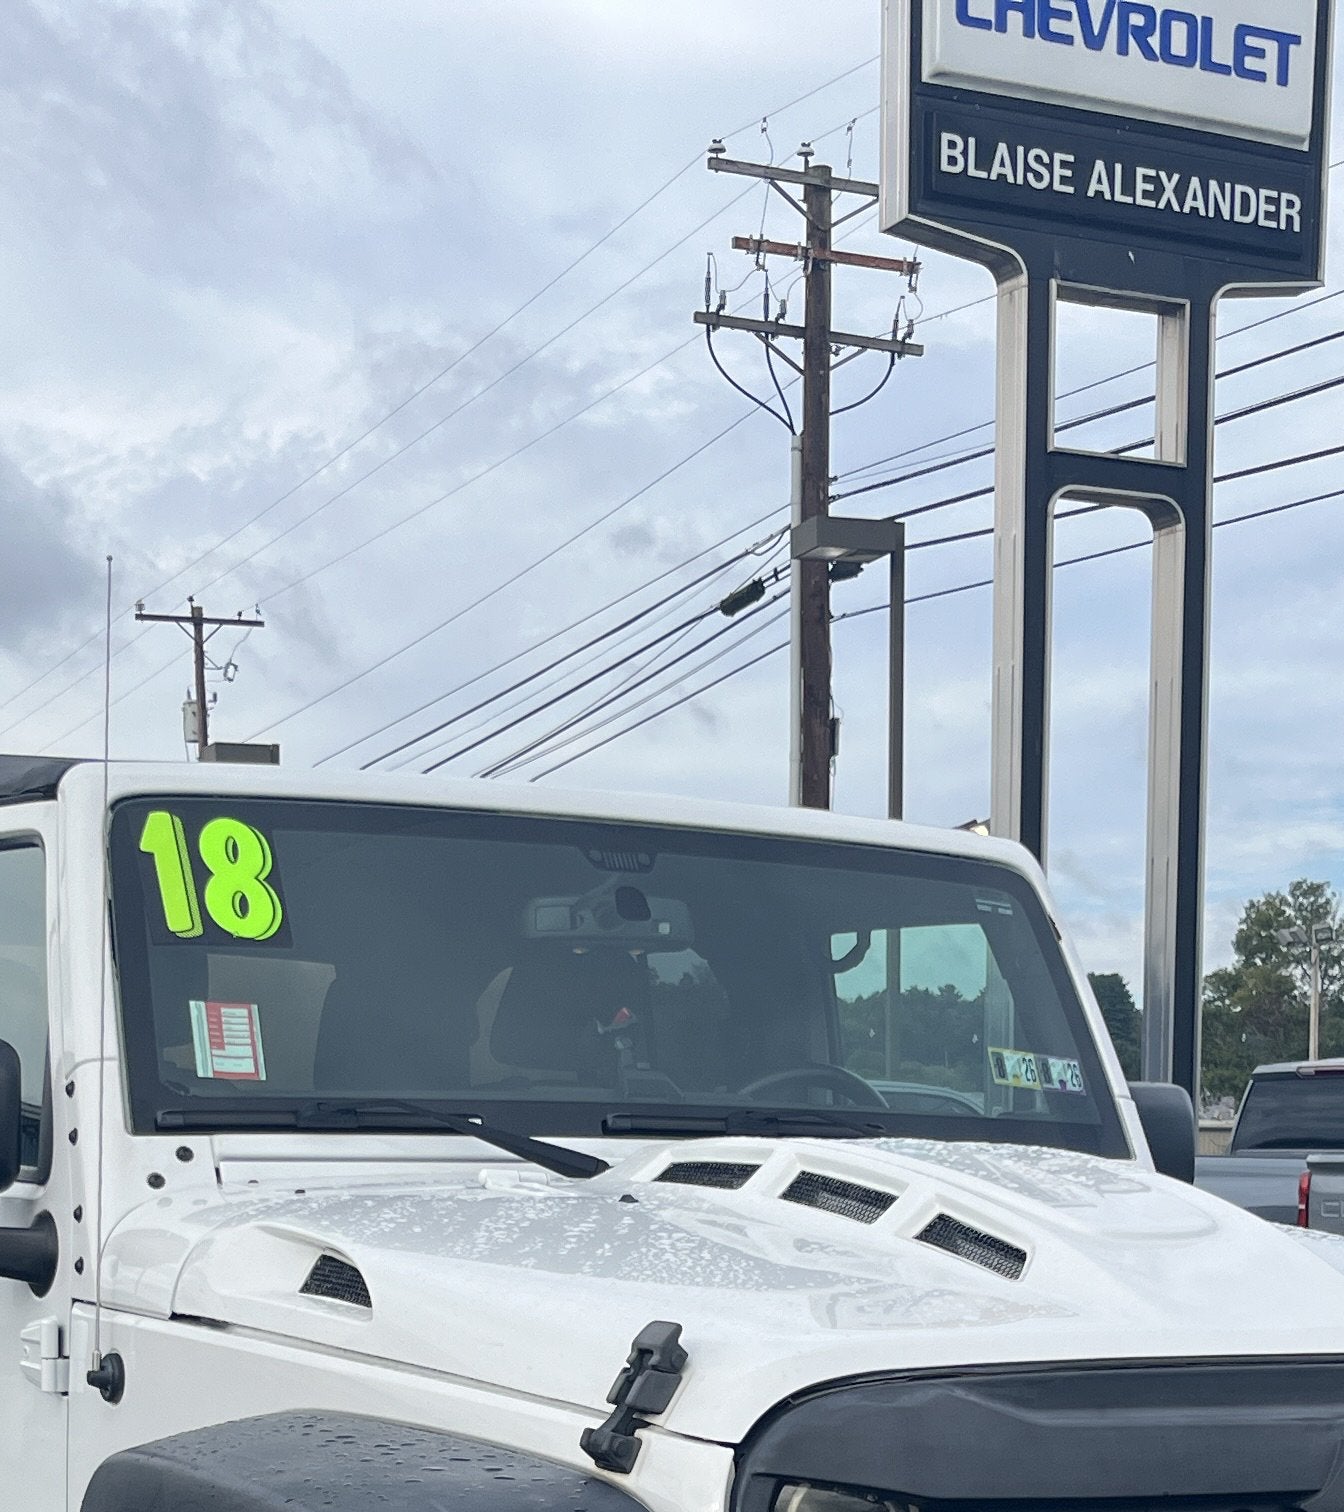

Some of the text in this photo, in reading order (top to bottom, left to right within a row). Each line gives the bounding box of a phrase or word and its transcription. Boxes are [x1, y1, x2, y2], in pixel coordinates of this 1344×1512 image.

[940, 131, 1303, 233] BLAISE ALEXANDER
[139, 809, 284, 942] 18
[1022, 1057, 1037, 1083] 26
